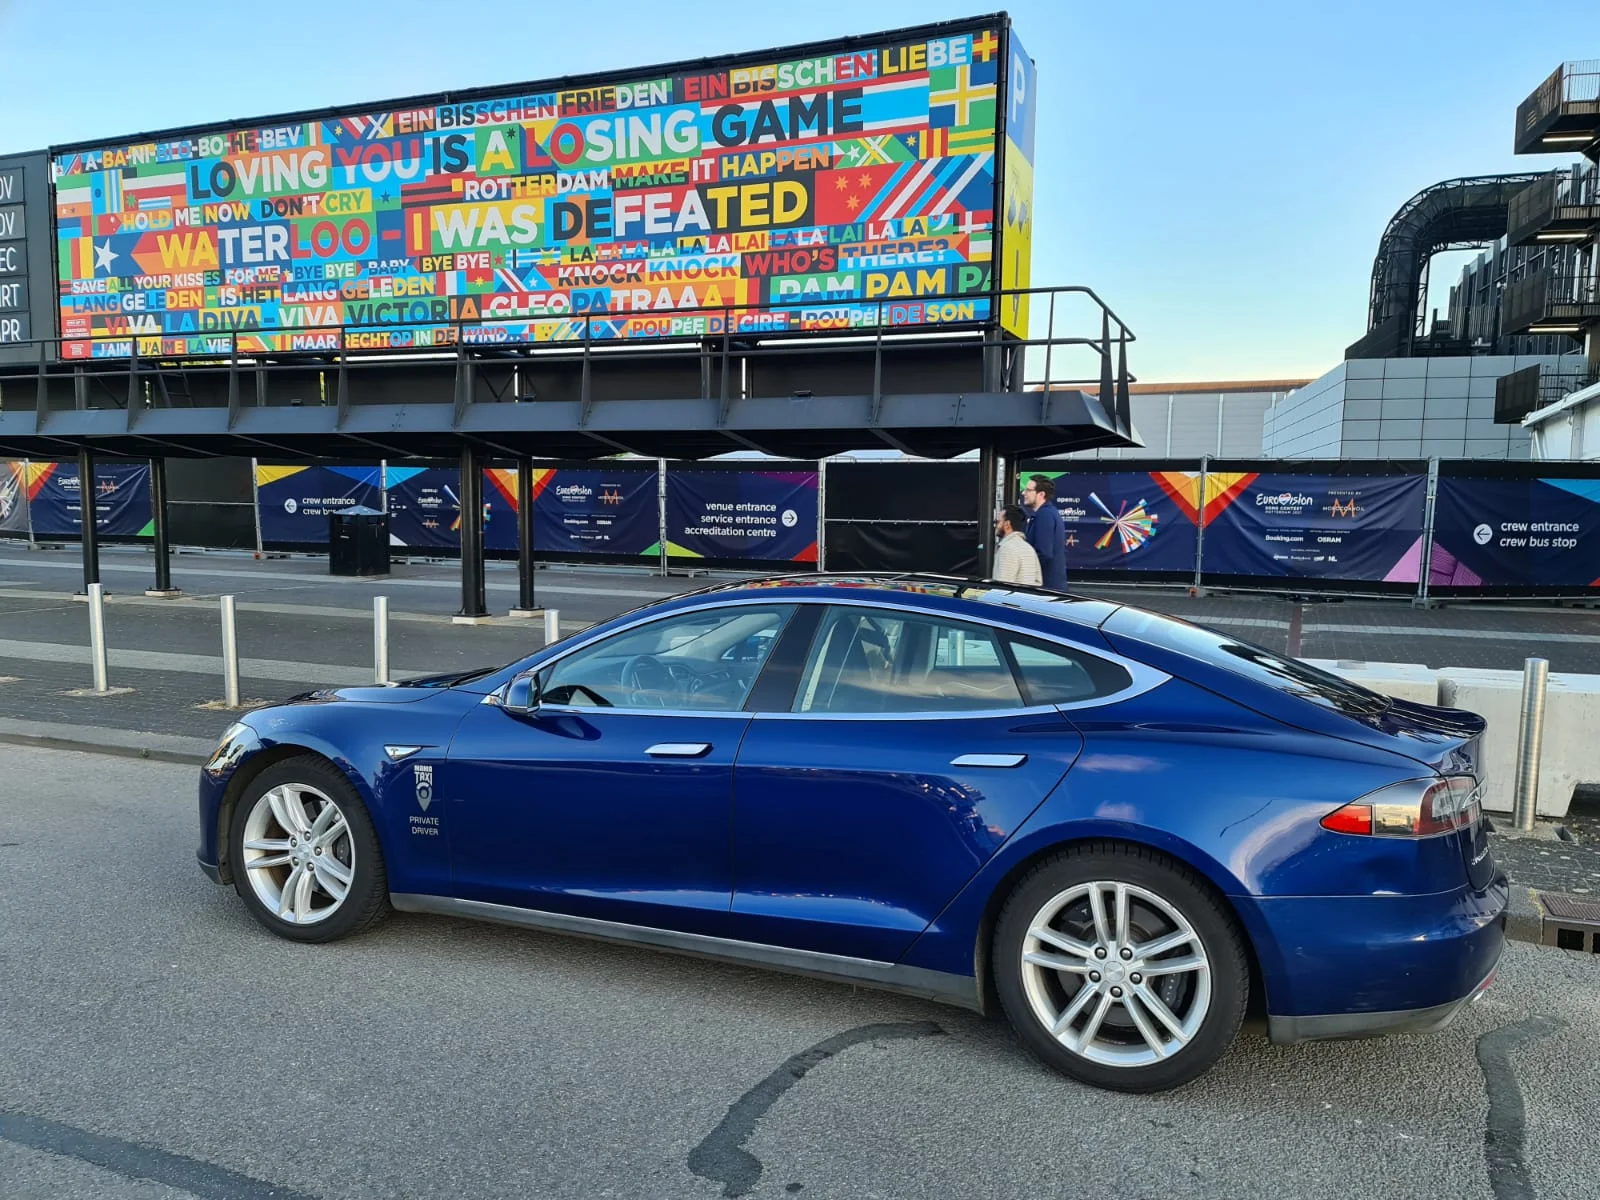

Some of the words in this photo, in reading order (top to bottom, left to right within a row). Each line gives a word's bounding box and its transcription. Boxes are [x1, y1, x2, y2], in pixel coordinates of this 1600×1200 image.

[398, 109, 435, 133] EIN
[440, 95, 555, 128] BISSCHEN
[561, 81, 668, 115] FRIEDEN
[684, 74, 727, 101] EIN
[734, 52, 873, 94] BISSCHEN
[882, 37, 967, 75] LIEBE
[190, 150, 327, 200] LOVING
[337, 139, 421, 184] YOU
[432, 134, 469, 175] IS
[480, 131, 515, 172] A
[526, 109, 698, 168] LOSING
[711, 87, 863, 148] GAME
[464, 169, 608, 201] ROTTERDAM
[615, 160, 686, 188] MAKE
[692, 158, 715, 181] IT
[722, 146, 830, 180] HAPPEN
[122, 210, 171, 231] HOLD
[175, 206, 200, 226] ME
[205, 202, 250, 223] NOW
[261, 195, 320, 219] DON'T
[325, 191, 365, 213] CRY
[156, 218, 370, 269] WATERLOO
[433, 204, 539, 249] WAS
[552, 180, 809, 245] DEFEATED
[294, 265, 323, 280] BYE
[325, 262, 355, 278] BYE
[368, 258, 409, 275] BABY
[422, 256, 453, 273] BYE
[456, 253, 490, 269] BYE
[558, 262, 643, 287] KNOCK
[648, 255, 738, 282] KNOCK
[744, 249, 835, 276] WHO'S
[843, 239, 949, 270] THERE?
[72, 279, 106, 294] SAVE
[108, 277, 132, 292] ALL
[134, 274, 171, 290] YOUR
[174, 271, 221, 288] KISSES
[224, 268, 254, 284] FOR
[257, 267, 280, 283] ME
[779, 274, 855, 304] PAM
[866, 269, 947, 299] PAM
[72, 293, 118, 314] LANG
[122, 288, 202, 311] GELEDEN
[220, 287, 237, 305] IS
[242, 285, 278, 304] HET
[282, 281, 338, 304] LANG
[341, 276, 435, 300] GELEDEN
[105, 315, 158, 335] VIVA
[165, 311, 194, 333] LA
[203, 309, 260, 332] DIVA
[278, 305, 341, 328] VIVA
[347, 297, 481, 326] VICTORIA
[632, 316, 705, 337] POUPÉE
[739, 312, 785, 332] CIRE
[804, 306, 888, 329] POUPÉE
[892, 305, 921, 325] DE
[927, 302, 974, 323] SON
[187, 341, 205, 354] LA
[208, 338, 231, 353] VIE
[292, 333, 337, 351] MAAR
[415, 329, 431, 346] IN
[436, 329, 456, 345] DE
[302, 497, 321, 505] crew
[322, 496, 356, 505] entrance
[705, 503, 734, 511] venue
[735, 502, 777, 512] entrance
[684, 525, 745, 537] accreditation
[746, 527, 777, 537] centre
[700, 513, 734, 523] service
[735, 513, 777, 525] entrance
[1500, 522, 1528, 532] crew
[1530, 521, 1580, 532] entrance
[1499, 537, 1527, 547] crew
[1529, 536, 1550, 547] bus
[1551, 537, 1577, 550] stop
[409, 815, 440, 826] PRIVATE
[411, 826, 439, 837] DRIVER
